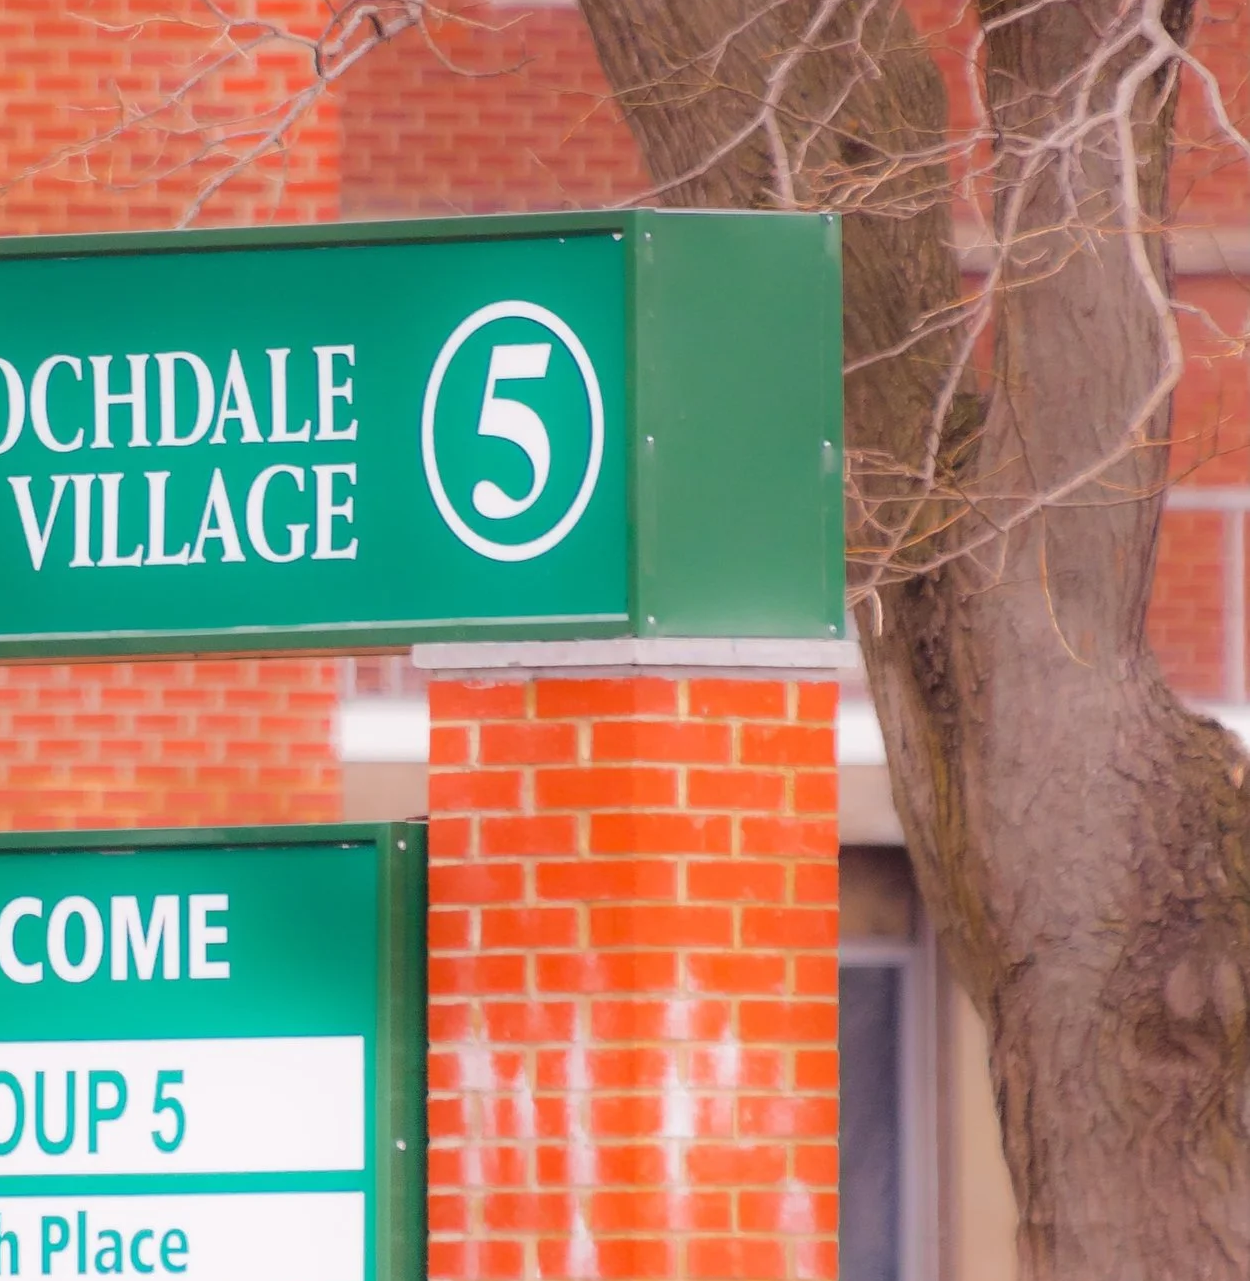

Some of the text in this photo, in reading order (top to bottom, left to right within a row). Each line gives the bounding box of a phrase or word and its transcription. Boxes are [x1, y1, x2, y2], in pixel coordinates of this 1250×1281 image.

[472, 343, 552, 519] 5
[8, 463, 358, 571] VILLAGE
[151, 1069, 187, 1154] 5
[40, 1210, 190, 1276] Place
